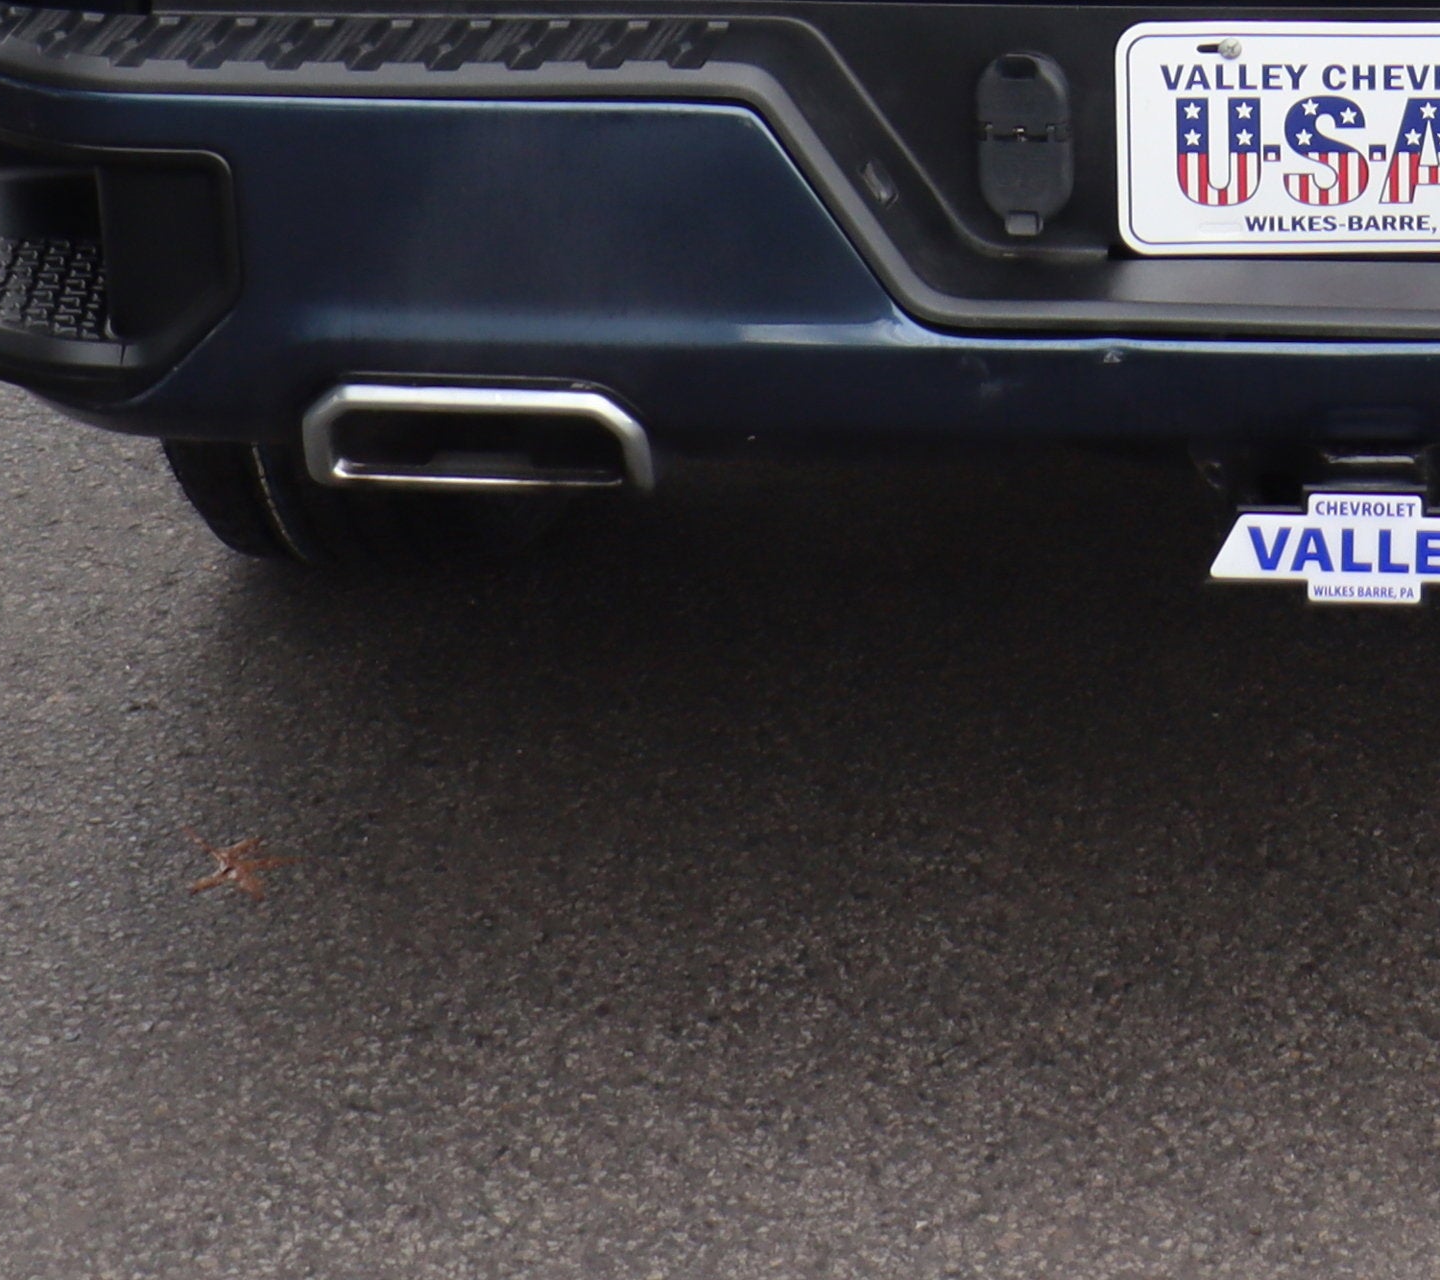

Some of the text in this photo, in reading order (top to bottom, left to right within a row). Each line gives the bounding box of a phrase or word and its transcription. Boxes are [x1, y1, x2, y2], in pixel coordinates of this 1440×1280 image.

[1159, 63, 1309, 91] VALLEY
[1245, 215, 1438, 235] WILKES-BARRE,
[1314, 500, 1416, 518] CHEVROLET
[1313, 585, 1415, 600] WILKES BARRE, PA
